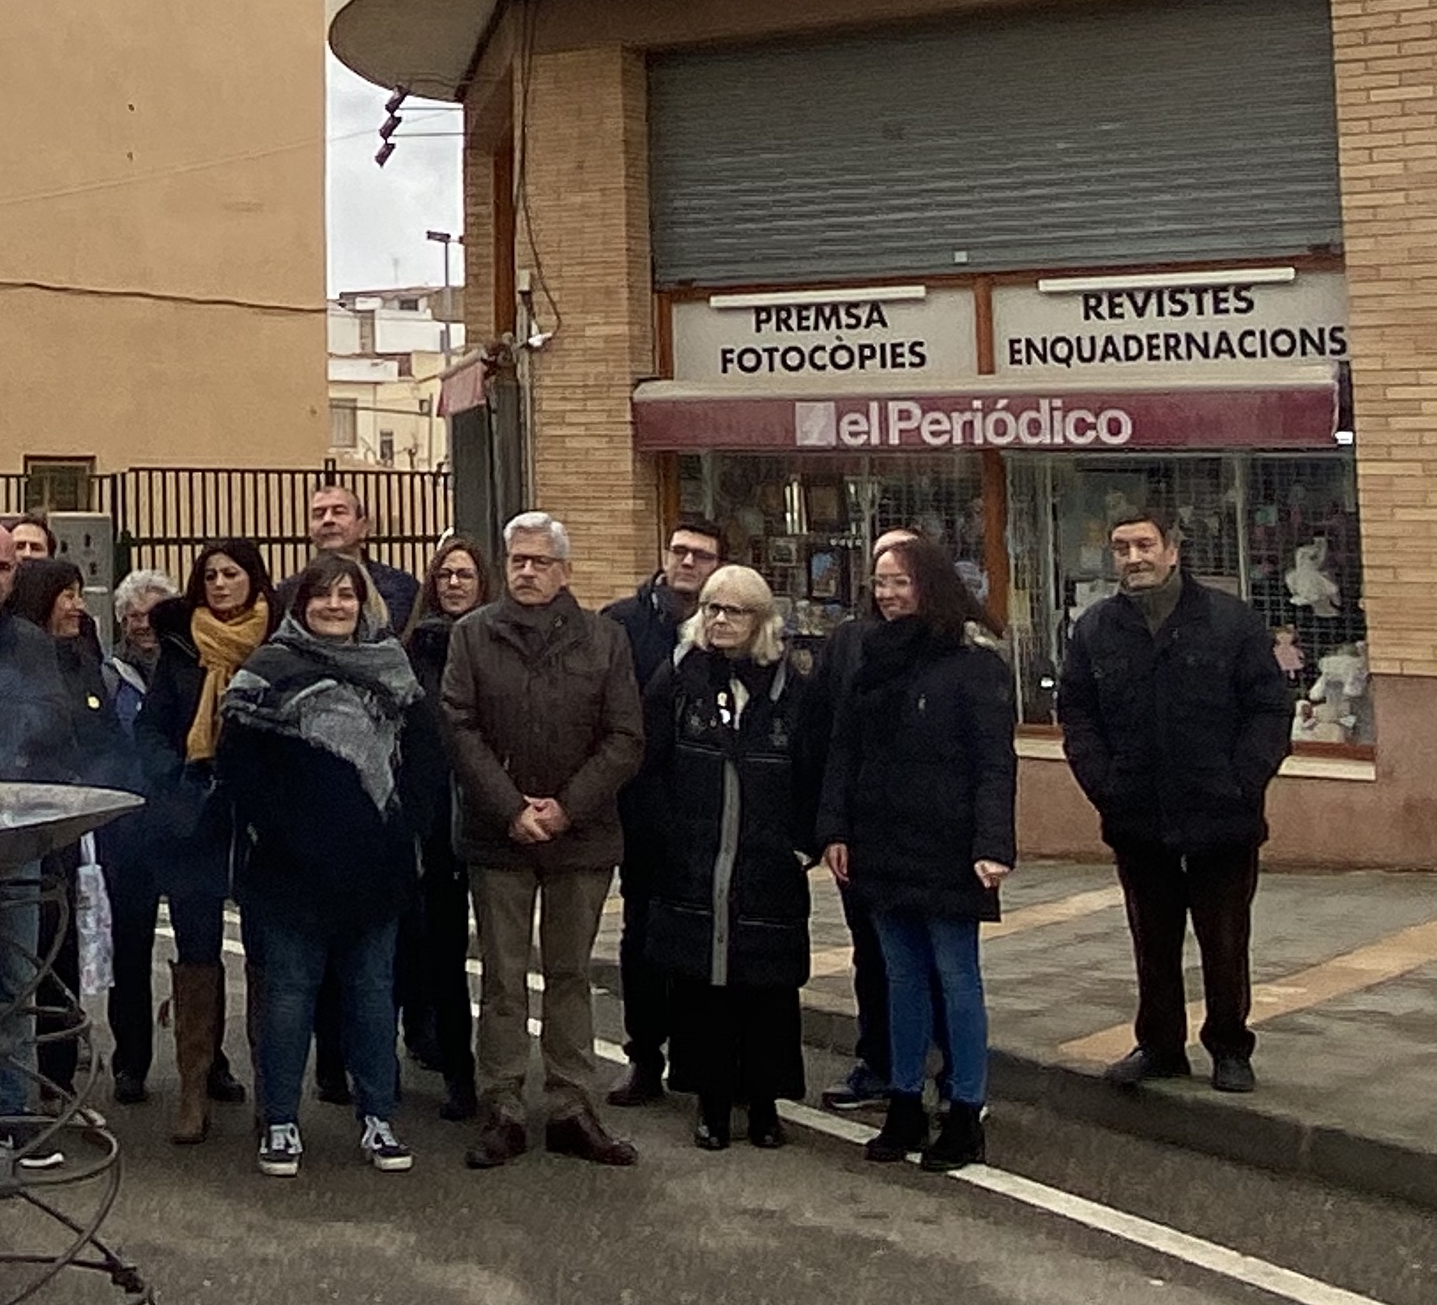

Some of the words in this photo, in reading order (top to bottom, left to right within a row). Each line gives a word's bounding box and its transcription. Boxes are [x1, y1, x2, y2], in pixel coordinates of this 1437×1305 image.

[753, 301, 888, 334] PREMSA
[1082, 286, 1255, 321] REVISTES
[720, 335, 927, 374] FOTOCÒPIES
[1008, 326, 1348, 368] ENQUADERNACIONS
[839, 401, 880, 446] el
[888, 399, 1133, 445] Periódico
